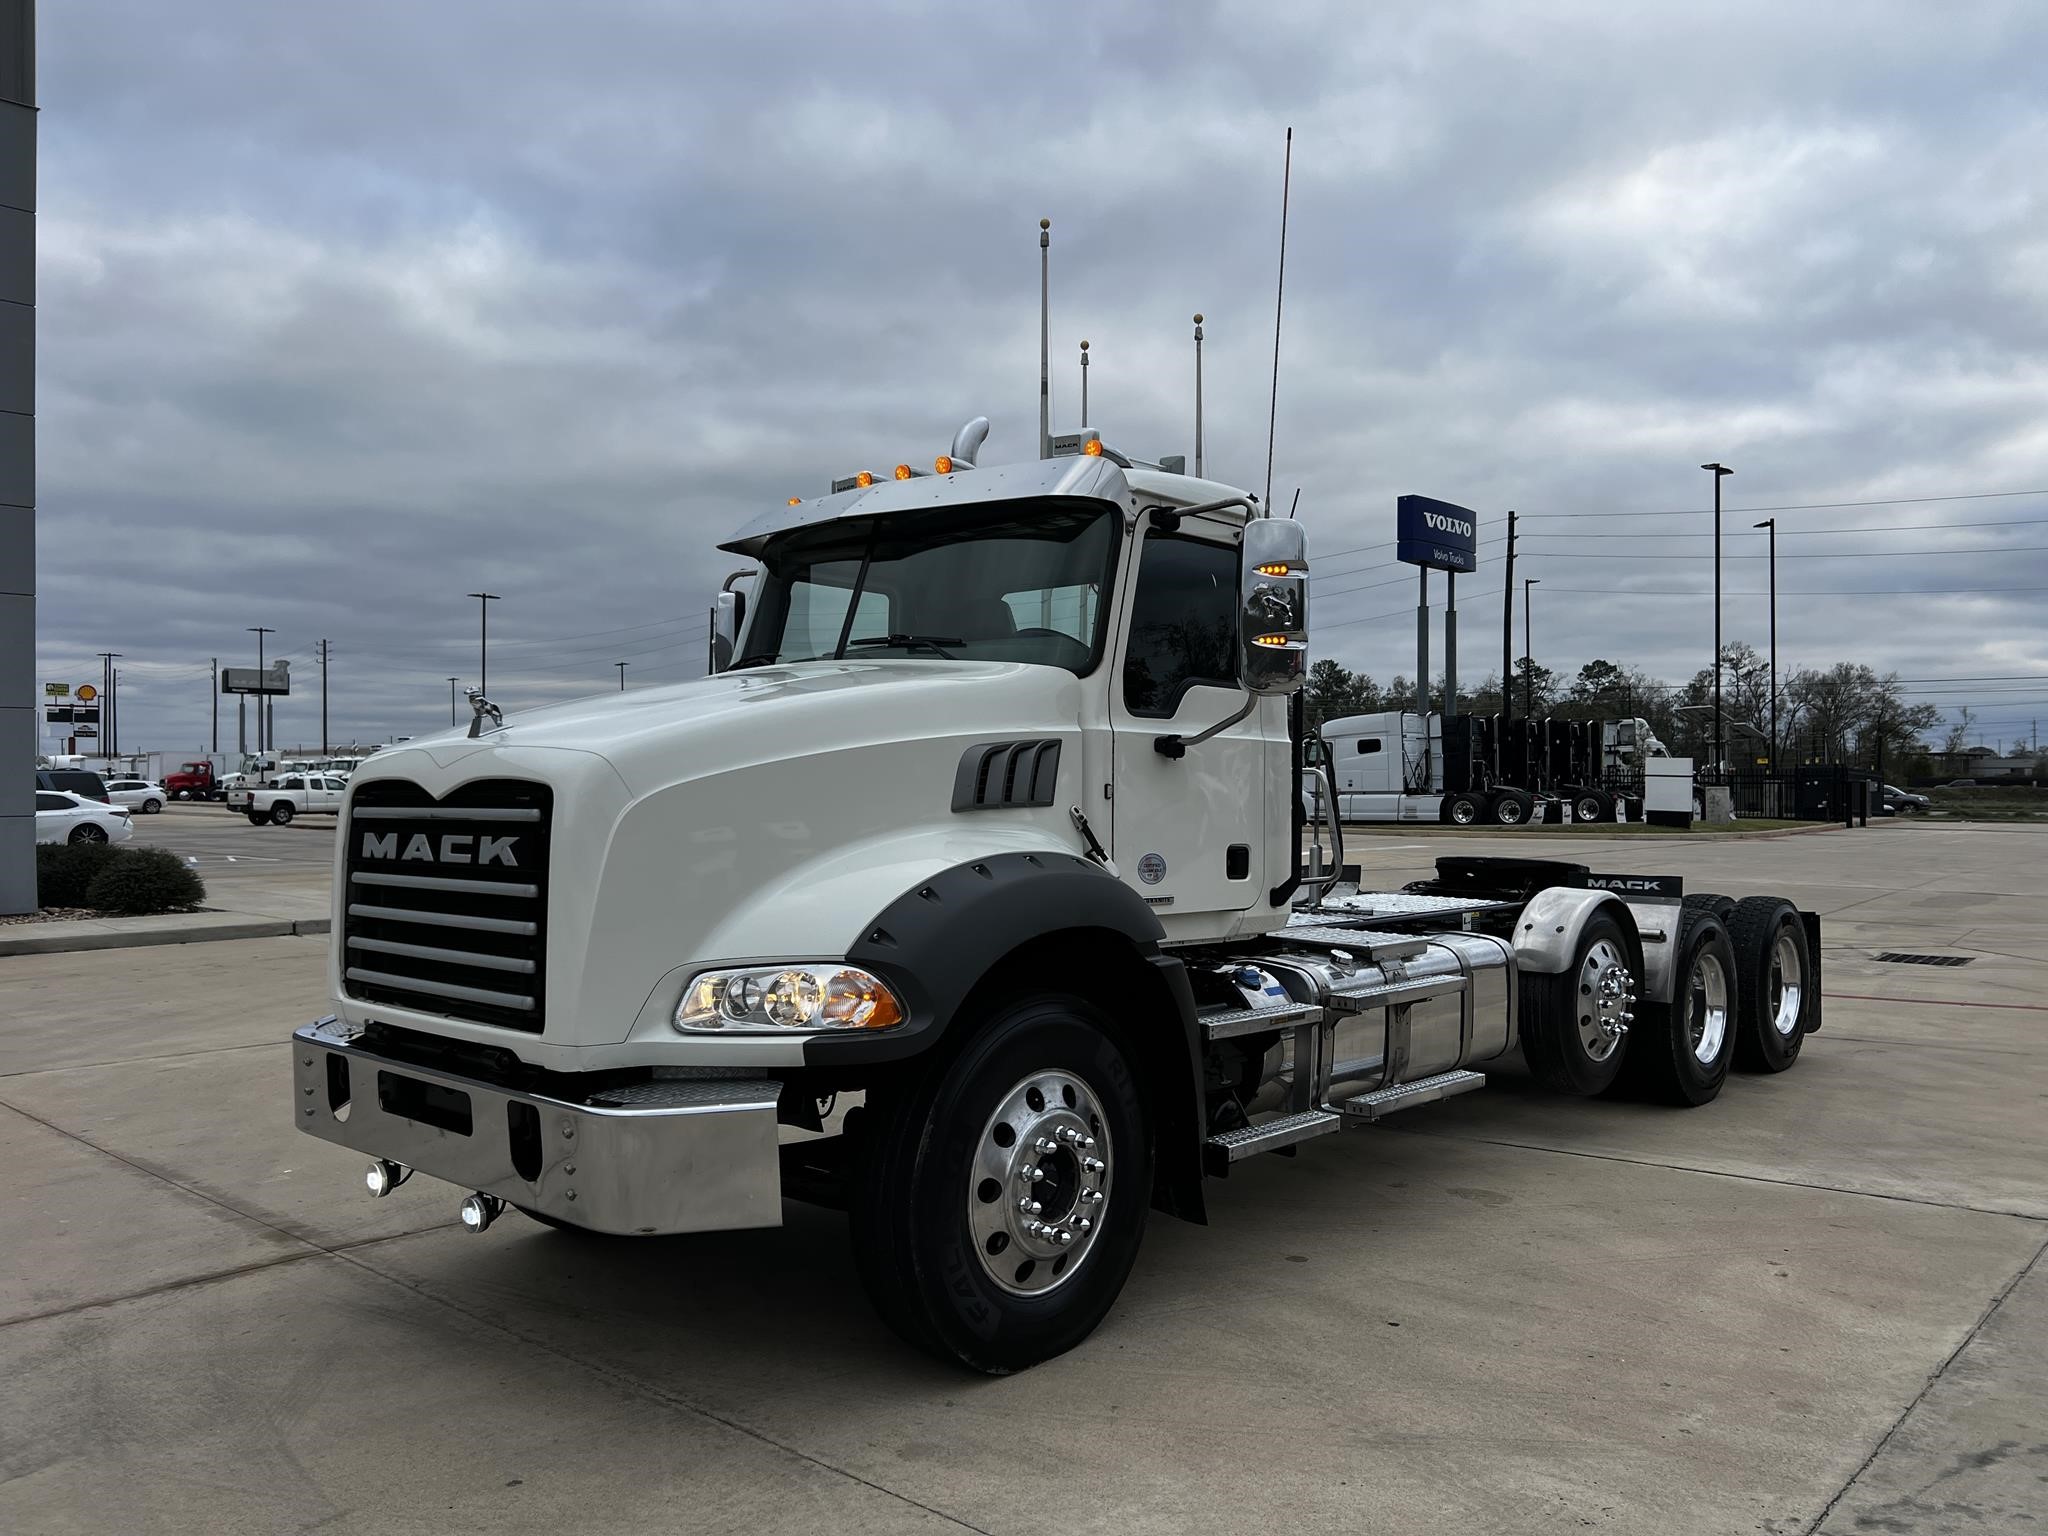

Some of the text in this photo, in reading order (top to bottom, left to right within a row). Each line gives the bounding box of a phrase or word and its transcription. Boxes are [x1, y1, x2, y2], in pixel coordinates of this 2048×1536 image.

[1423, 512, 1472, 538] VOLVO
[1433, 549, 1465, 566] Volvo Trucks
[361, 832, 521, 867] MACK
[1587, 878, 1662, 891] MACK
